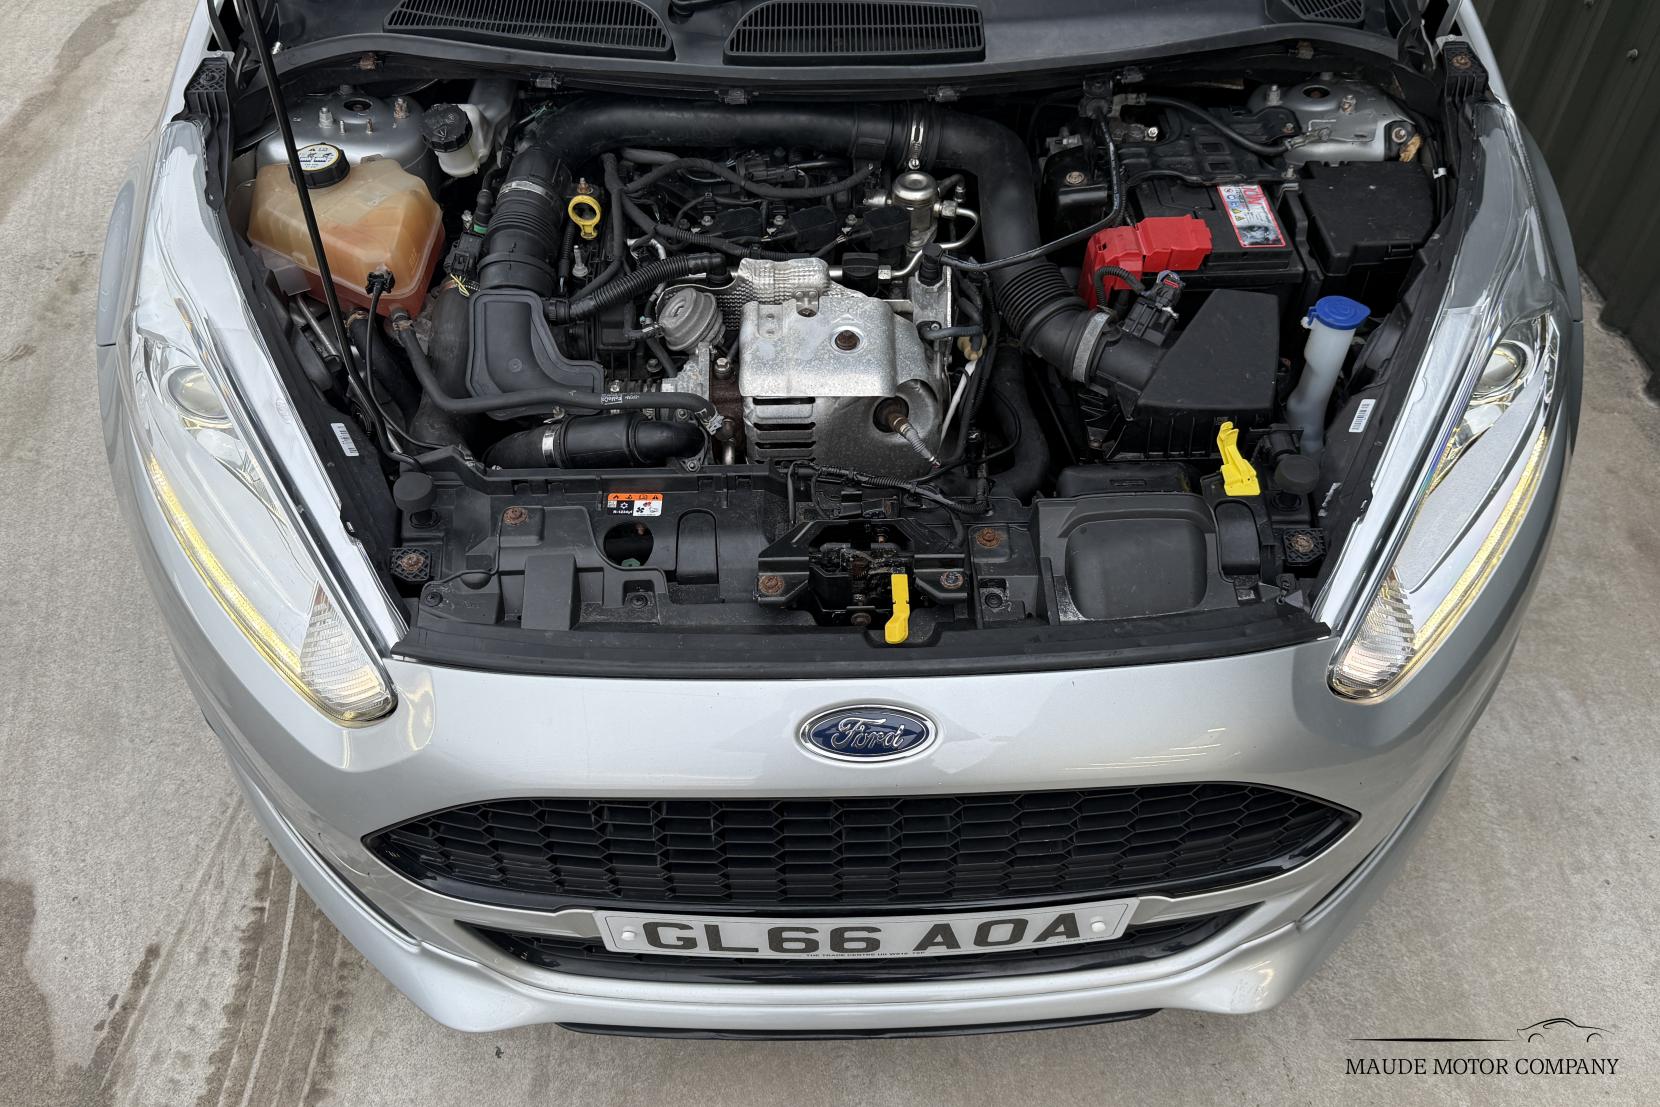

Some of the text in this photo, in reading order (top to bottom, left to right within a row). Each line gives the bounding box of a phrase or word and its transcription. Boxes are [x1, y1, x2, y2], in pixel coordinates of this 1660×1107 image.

[831, 717, 905, 749] Ford
[642, 912, 1080, 953] GL66 AOA
